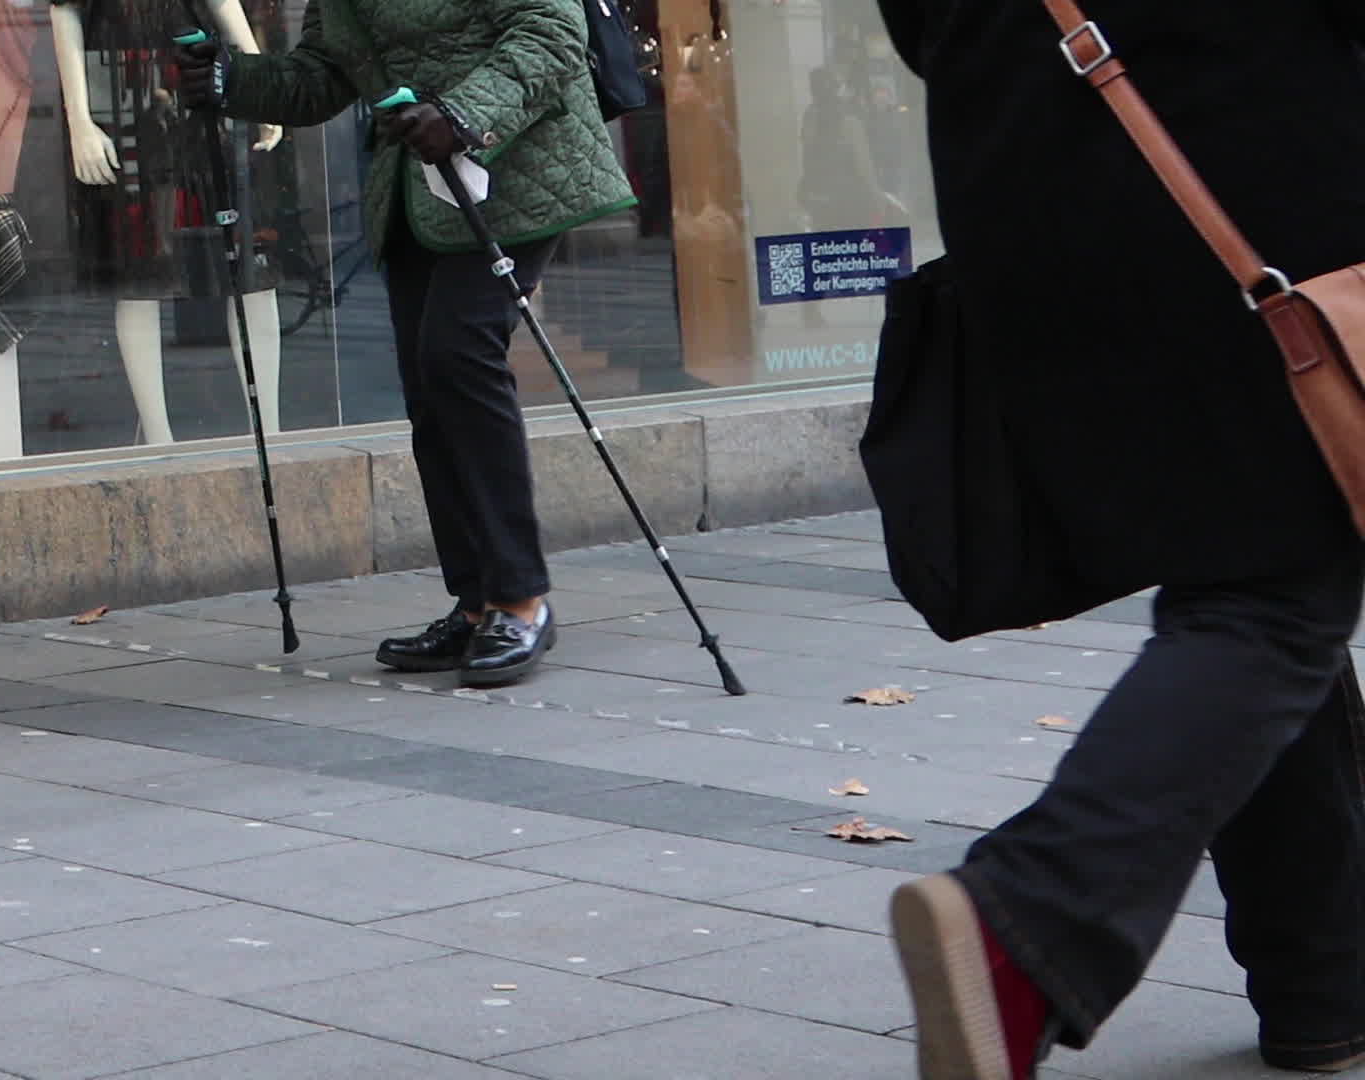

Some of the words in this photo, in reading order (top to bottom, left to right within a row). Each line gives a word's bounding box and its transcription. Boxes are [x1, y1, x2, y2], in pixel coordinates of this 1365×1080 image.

[810, 240, 858, 256] Entdecke
[859, 239, 875, 253] die
[812, 257, 869, 274] Geschichte
[870, 255, 899, 270] hinter
[813, 278, 831, 291] der
[832, 275, 885, 291] Kampagne
